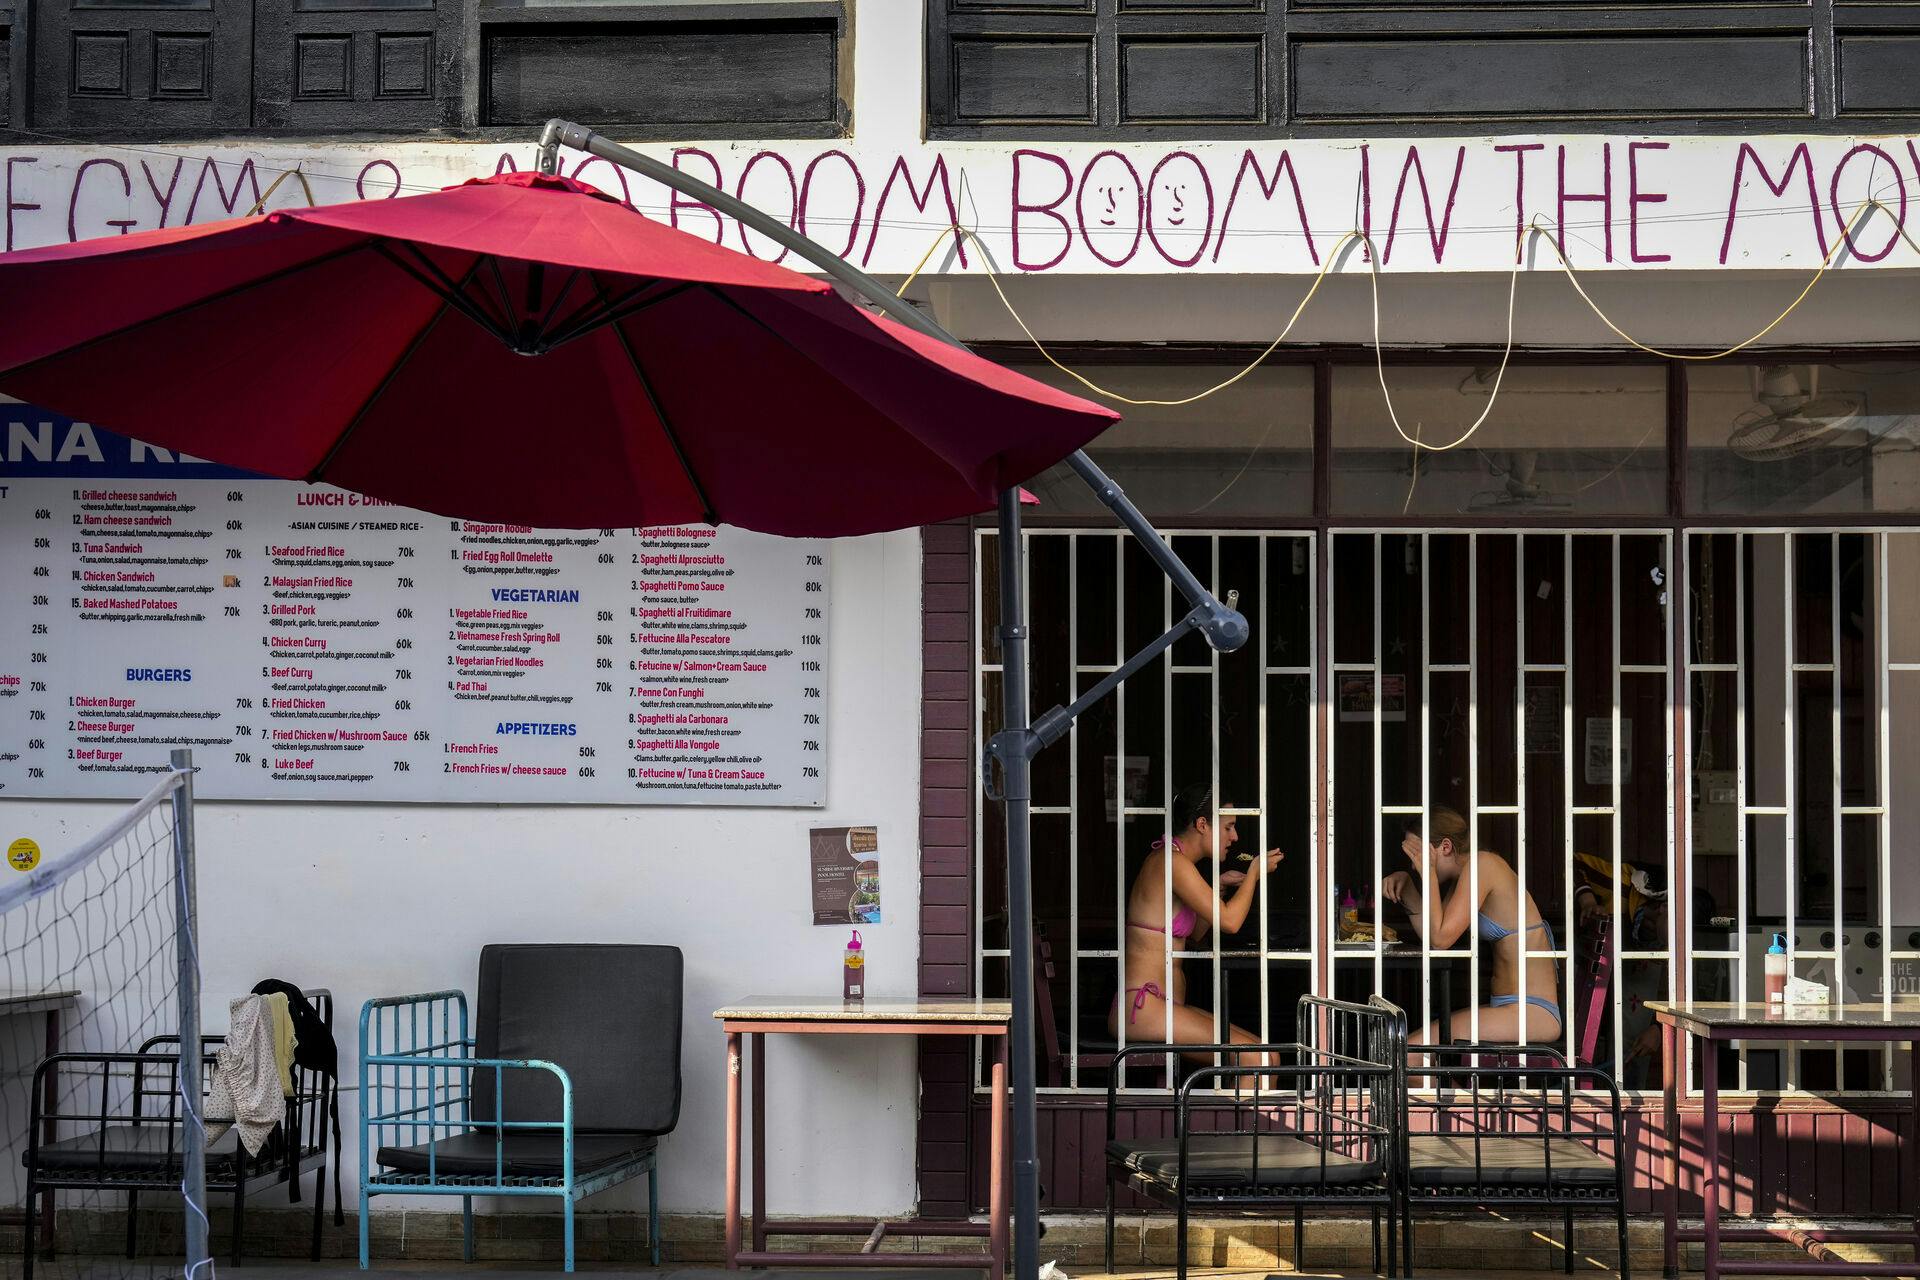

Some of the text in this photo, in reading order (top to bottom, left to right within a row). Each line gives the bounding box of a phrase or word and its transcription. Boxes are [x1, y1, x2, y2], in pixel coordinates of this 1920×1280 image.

[671, 147, 967, 269] BOOM
[1011, 147, 1320, 271] BOOM
[1360, 144, 1466, 265] IN
[1494, 143, 1671, 265] THE
[82, 490, 243, 501] Grilled cheese sandwich 60k
[298, 493, 343, 506] LUNCH
[35, 509, 50, 519] 60k
[84, 515, 242, 530] Ham cheese sandwich 60k
[318, 522, 349, 530] CUISINE
[359, 522, 398, 530] STEAMED
[463, 522, 503, 533] Singapore
[638, 528, 716, 539] Spaghetti Bolognese
[35, 538, 50, 548] 50k
[84, 543, 241, 558] Tuna Sandwich 70k
[272, 546, 414, 557] Seafood Fried Rice 70k
[463, 551, 552, 563] Fried Egg Roll Omelette
[641, 554, 677, 566] Spaghetti
[84, 571, 154, 581] Chicken Sandwich
[273, 577, 413, 589] Malaysian Fried Rice 70k
[640, 581, 821, 592] Spaghetti Pomo Sauce 80k
[492, 589, 578, 602] VEGETARIAN
[84, 599, 240, 616] Baked Mashed Potatoes 70k
[272, 605, 412, 618] Grilled Pork 60k
[639, 607, 675, 619] Spaghetti
[677, 608, 684, 617] al
[456, 609, 527, 620] Vegetable Fried Rice
[32, 624, 47, 634] 25k
[271, 637, 326, 649] Chicken Curry
[457, 631, 560, 644] Vietnamese Fresh Spring Roll
[639, 634, 820, 644] Fettucine Alla Pescatore 110k
[456, 656, 543, 667] Vegetarian Fried Noodles
[673, 660, 683, 671] w/
[743, 662, 766, 671] Sauce
[802, 662, 820, 671] 110k
[127, 669, 191, 681] BURGERS
[272, 667, 312, 680] Beef Curry
[31, 682, 46, 691] 70k
[457, 682, 487, 691] Pad Thai
[638, 687, 704, 699] Penne Con Funghi
[76, 697, 252, 709] Chicken Burger 70k
[272, 698, 325, 708] Fried Chicken
[638, 714, 728, 725] Spaghetti ala Carbonara
[78, 721, 251, 735] Cheese Burger 70k
[496, 723, 576, 735] APPETIZERS
[273, 729, 429, 741] Fried Chicken w/ Mushroom Sauce 65k
[451, 743, 498, 754] French Fries
[637, 739, 719, 751] Spaghetti Alla Vongole
[77, 749, 250, 762] Beef Burger 70k
[276, 759, 313, 769] Luke Beef
[453, 763, 479, 773] French
[481, 764, 499, 773] Fries
[501, 763, 511, 775] w/
[513, 765, 541, 774] cheese
[639, 767, 764, 779] Fettucine w/ Tuna & Cream Sauce
